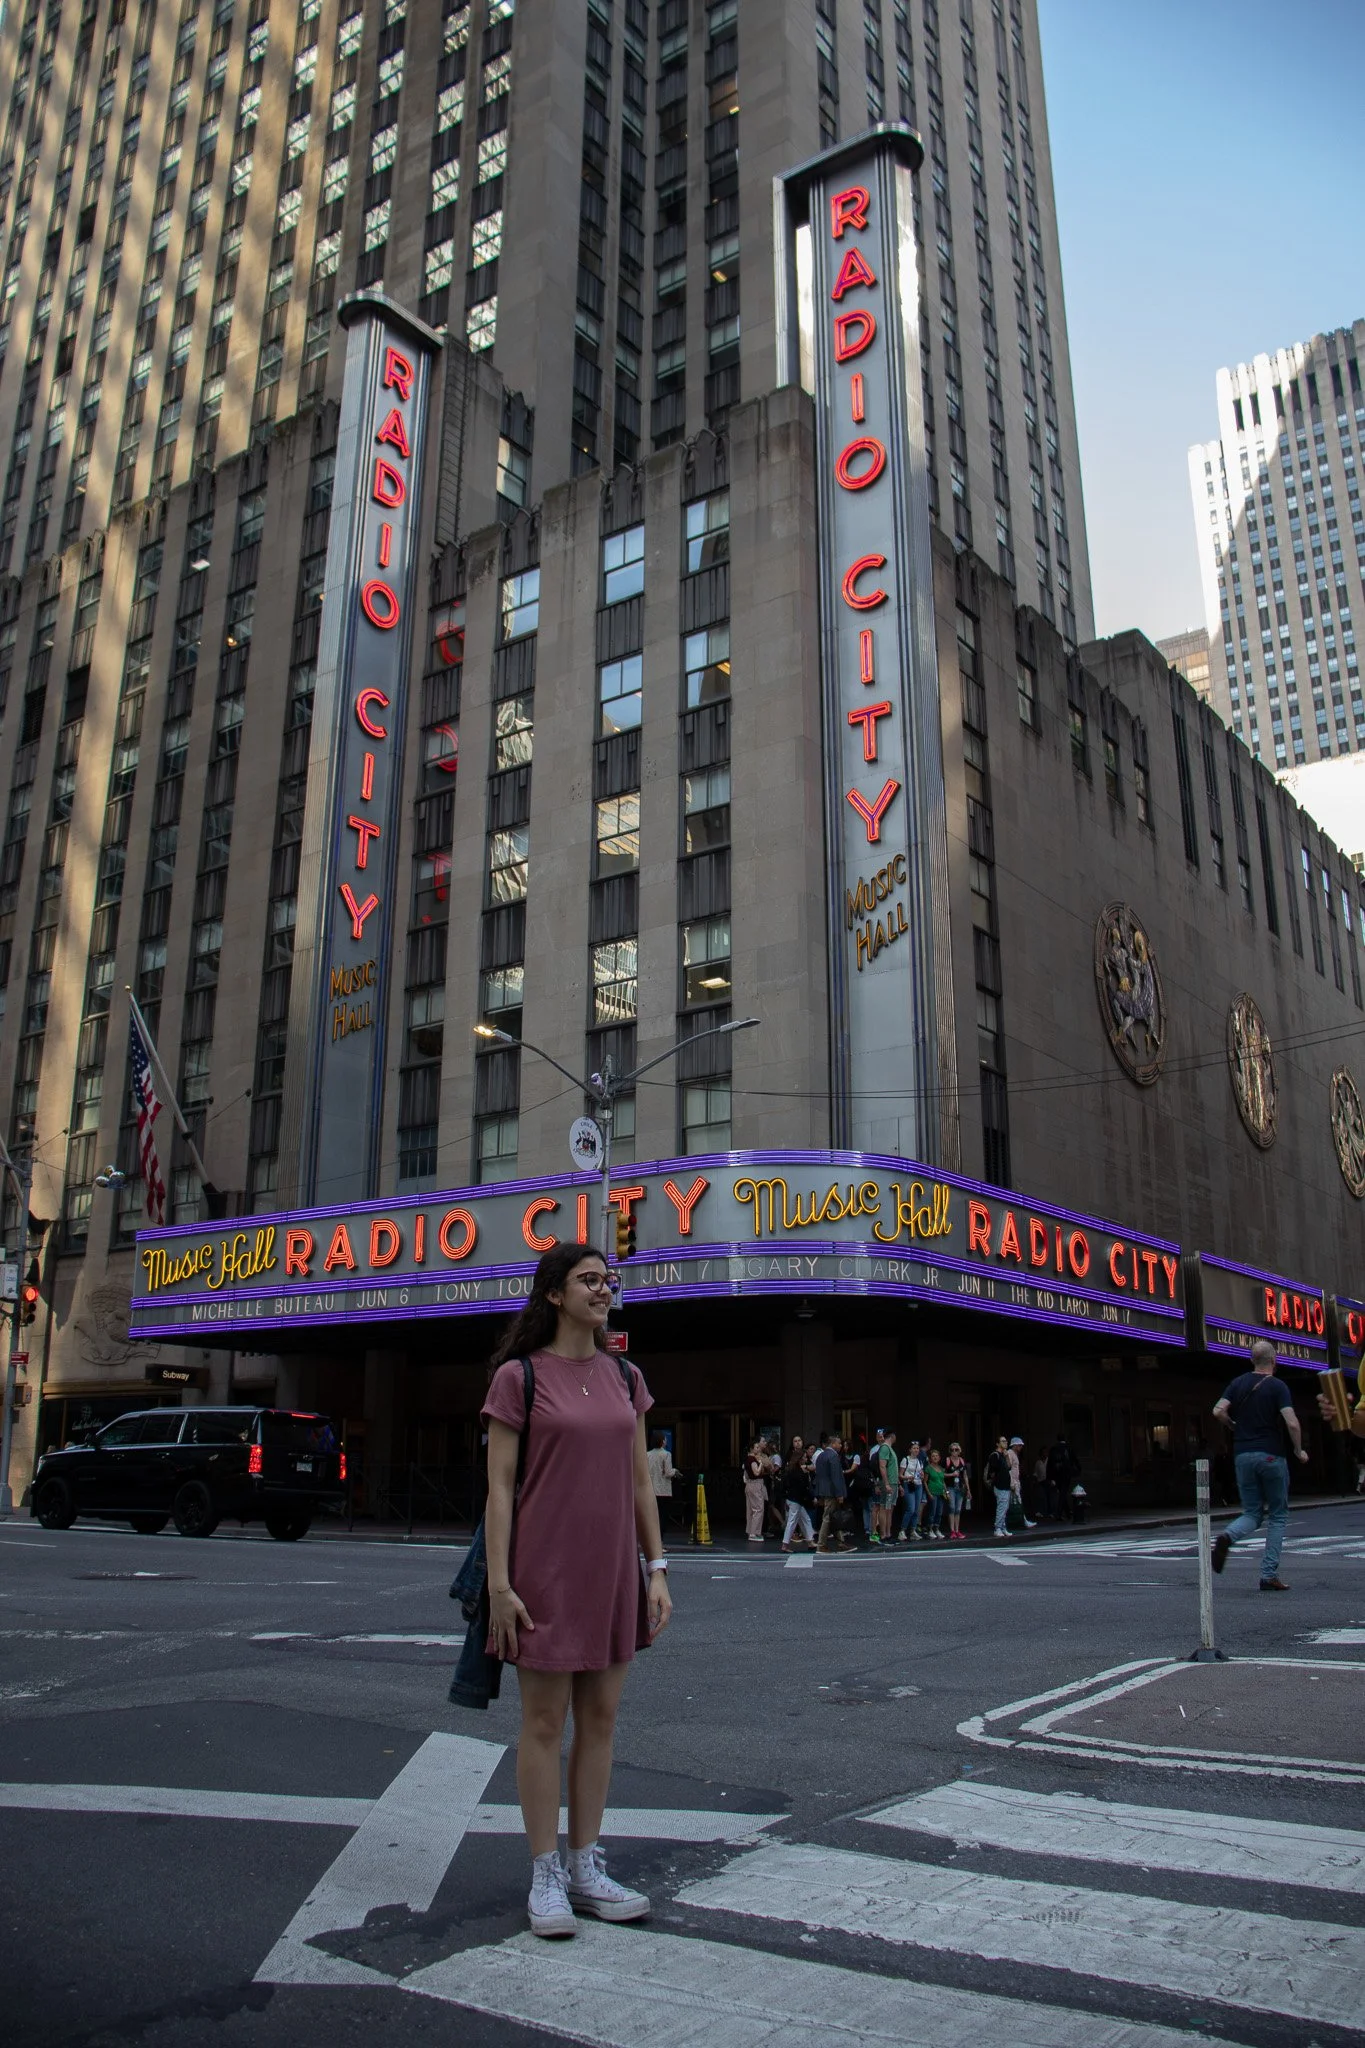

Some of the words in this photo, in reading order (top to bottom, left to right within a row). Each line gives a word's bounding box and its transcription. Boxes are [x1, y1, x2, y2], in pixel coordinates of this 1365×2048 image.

[831, 185, 887, 491] RADIO
[361, 346, 415, 630] RADIO
[841, 553, 900, 843] CITY
[340, 687, 389, 940] CITY
[846, 853, 906, 931] MUSIC
[855, 902, 909, 972] HALL
[329, 959, 376, 1002] MUSIC
[331, 1002, 375, 1041] HALL
[285, 1207, 477, 1276] RADIO
[521, 1176, 708, 1251] CITY
[733, 1177, 881, 1237] Music
[873, 1181, 953, 1243] Hall
[141, 1243, 213, 1293] Music
[206, 1224, 278, 1290] Hall
[747, 1256, 818, 1278] GARY
[838, 1256, 911, 1282] CLARK
[922, 1266, 942, 1288] JR.
[957, 1273, 981, 1296] JUN
[969, 1200, 1091, 1278] RADIO
[1109, 1241, 1178, 1299] CITY
[192, 1300, 263, 1321] MICHELLE
[274, 1293, 335, 1315] BUTEAU
[356, 1288, 388, 1309] JUN
[399, 1287, 409, 1305] 6
[434, 1280, 482, 1302] TONY
[497, 1275, 535, 1297] TOU
[642, 1262, 682, 1285] JUN
[699, 1260, 710, 1280] 7
[1010, 1284, 1031, 1305] THE
[1036, 1289, 1054, 1309] KID
[1059, 1294, 1090, 1316] LAROI
[1101, 1304, 1118, 1322] JUN
[1122, 1308, 1130, 1324] 17
[1264, 1287, 1324, 1335] RADIO
[1217, 1329, 1236, 1345] LIZZY
[162, 1369, 190, 1382] Subway
